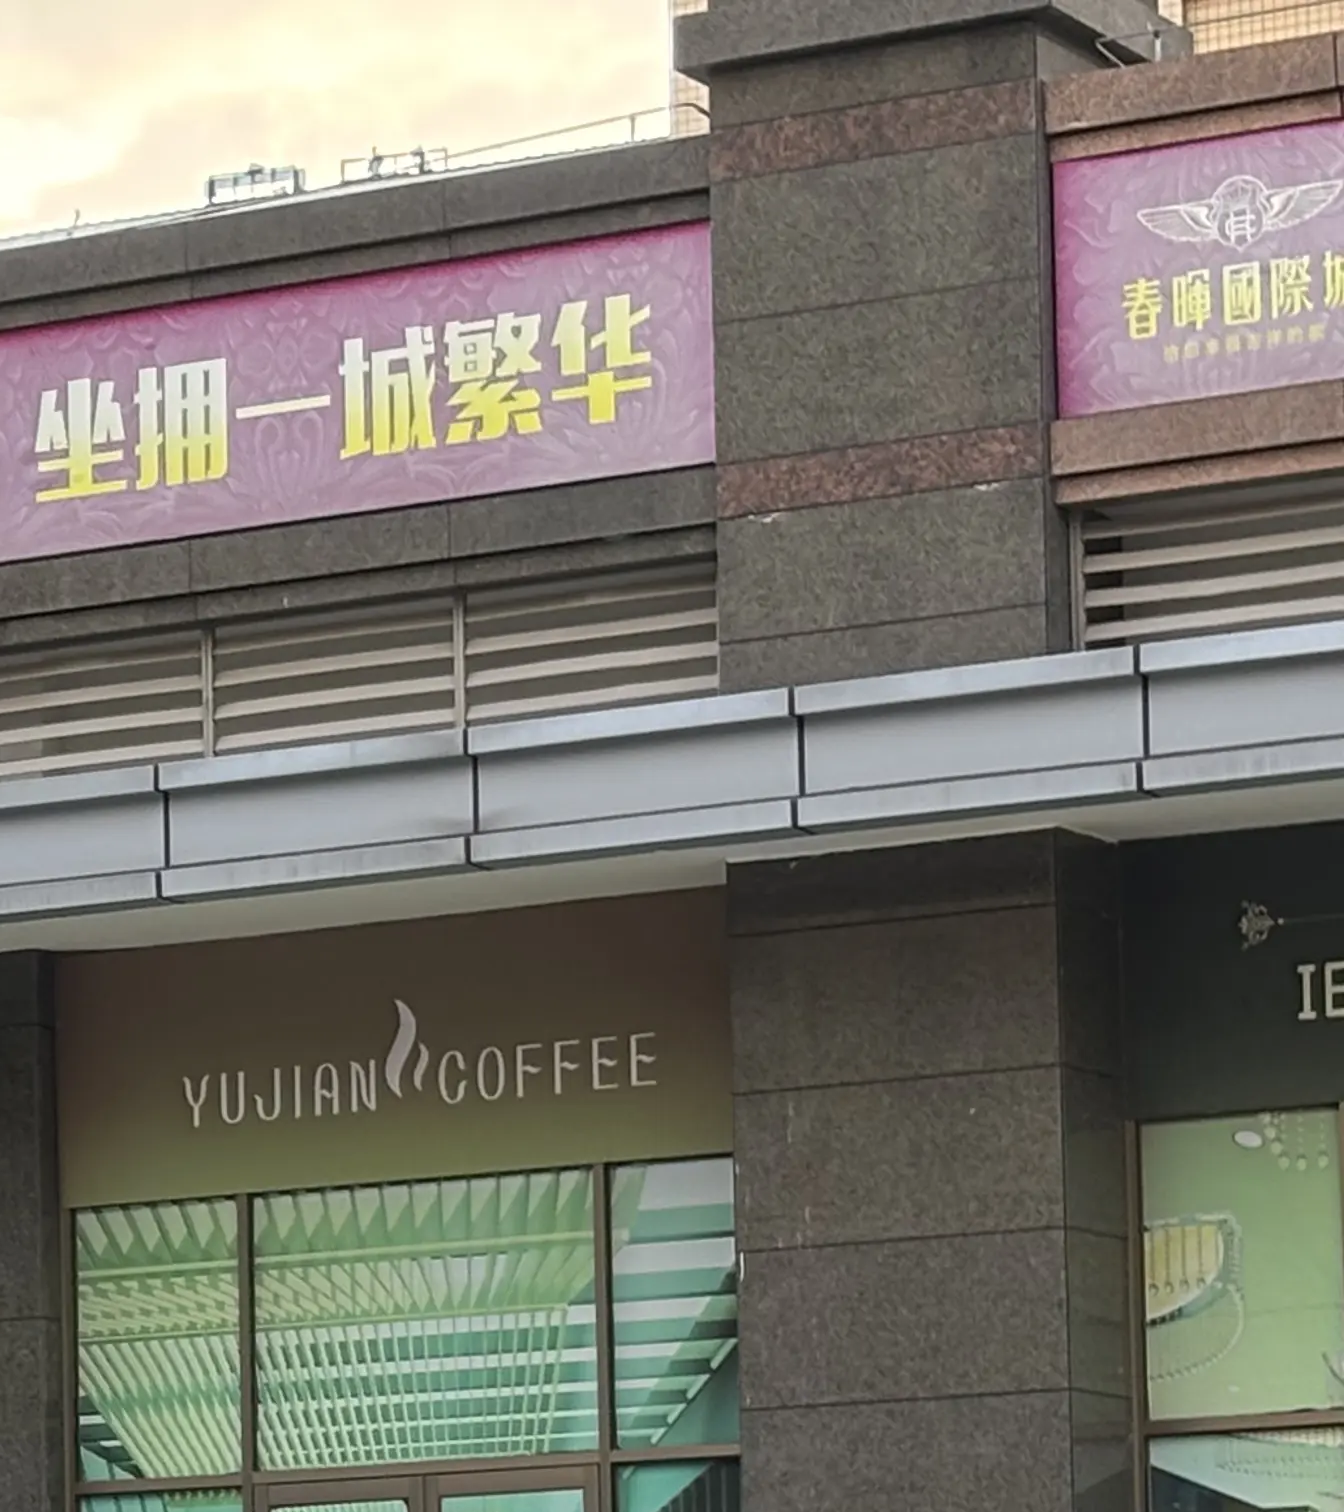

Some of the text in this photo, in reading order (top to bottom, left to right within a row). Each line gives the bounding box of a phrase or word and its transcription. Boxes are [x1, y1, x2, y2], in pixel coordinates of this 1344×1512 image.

[34, 293, 653, 503] 坐拥一城繁华
[183, 1032, 657, 1128] YUJIAN COFFEE
